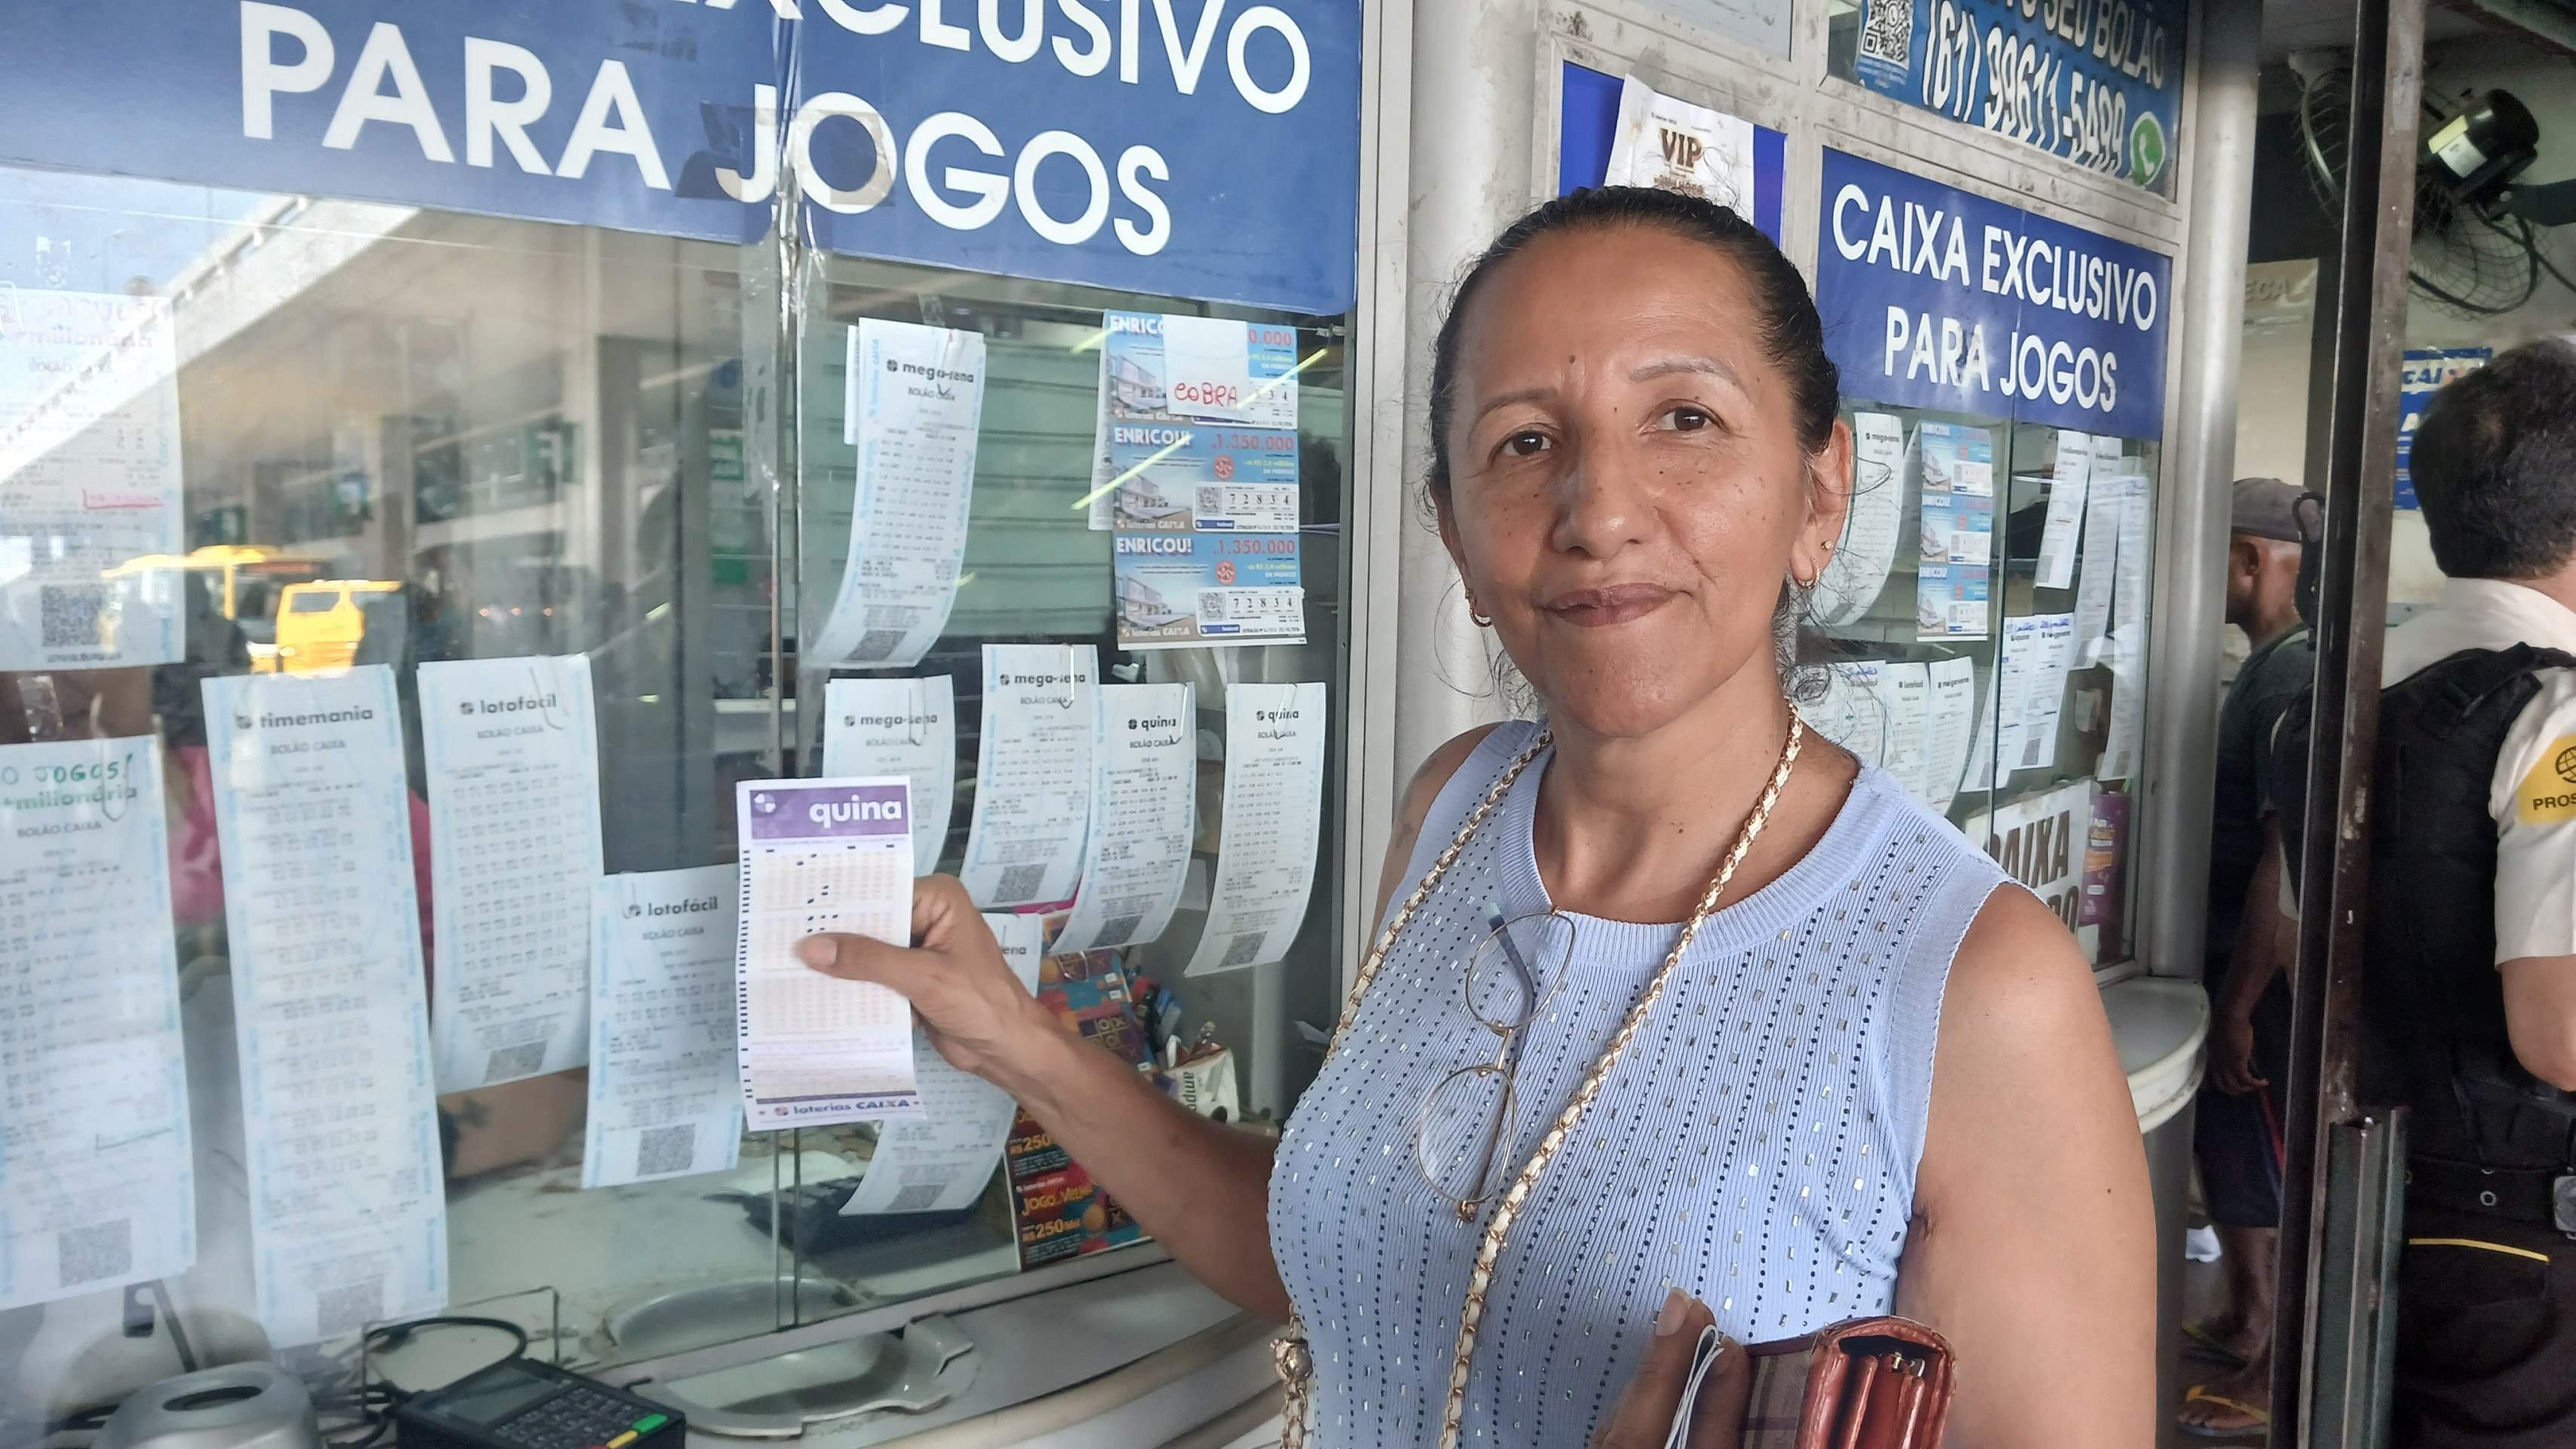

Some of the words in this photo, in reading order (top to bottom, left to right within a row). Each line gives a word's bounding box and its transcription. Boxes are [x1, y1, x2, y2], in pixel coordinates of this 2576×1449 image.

[2044, 0, 2089, 47] SEU
[667, 0, 1310, 114] USIVO
[1922, 0, 1981, 123] (61)
[240, 0, 672, 190] PARA
[715, 83, 1172, 256] JOGOS
[1660, 127, 1703, 168] VIP
[1833, 183, 1971, 286] CAIXA
[1981, 224, 2158, 331] EXCLUSIVO
[1109, 314, 1163, 335] ENRIC
[1248, 328, 1293, 346] 0.000
[1885, 305, 1990, 391] PARA
[1999, 331, 2117, 412] JOGOS
[902, 363, 975, 383] mega-sena
[1116, 537, 1193, 553] ENRICOU!
[1218, 539, 1296, 555] 1.350.000
[480, 693, 557, 714] lotofácil
[259, 705, 373, 728] timemania
[1141, 715, 1177, 732] quina
[1268, 707, 1300, 724] quina
[270, 741, 309, 755] BOLÃO
[809, 794, 902, 829] quina
[17, 823, 61, 838] BOLÃO
[1983, 809, 2070, 889] AIXA
[648, 896, 718, 917] lotofácil
[793, 1102, 852, 1115] loterias
[856, 1099, 911, 1110] CAIXA
[1023, 1134, 1051, 1152] 250
[1021, 1194, 1056, 1217] JOGO
[1035, 1218, 1064, 1239] 250
